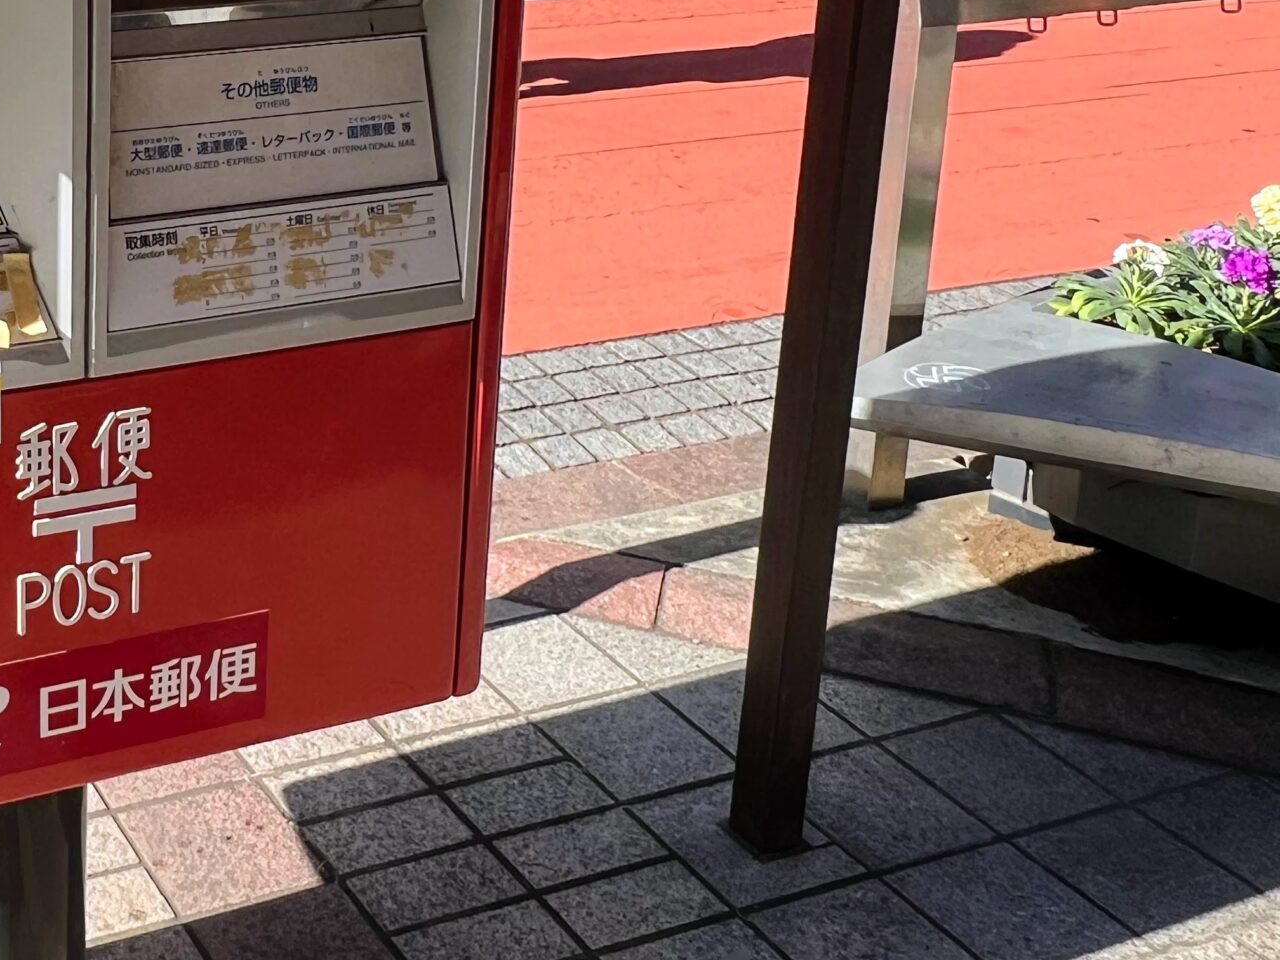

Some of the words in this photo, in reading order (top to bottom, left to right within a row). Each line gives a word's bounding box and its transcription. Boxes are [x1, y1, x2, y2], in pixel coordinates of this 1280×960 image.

[221, 74, 319, 100] その他郵便物
[255, 99, 291, 110] OTHERS
[367, 204, 385, 216] 休日
[286, 214, 313, 227] 土曜日
[124, 229, 178, 251] 取集時刻
[199, 225, 219, 238] 平日
[127, 250, 165, 262] Collection
[15, 406, 153, 502] 郵便
[15, 551, 152, 638] POST
[38, 642, 258, 739] 日本郵便
